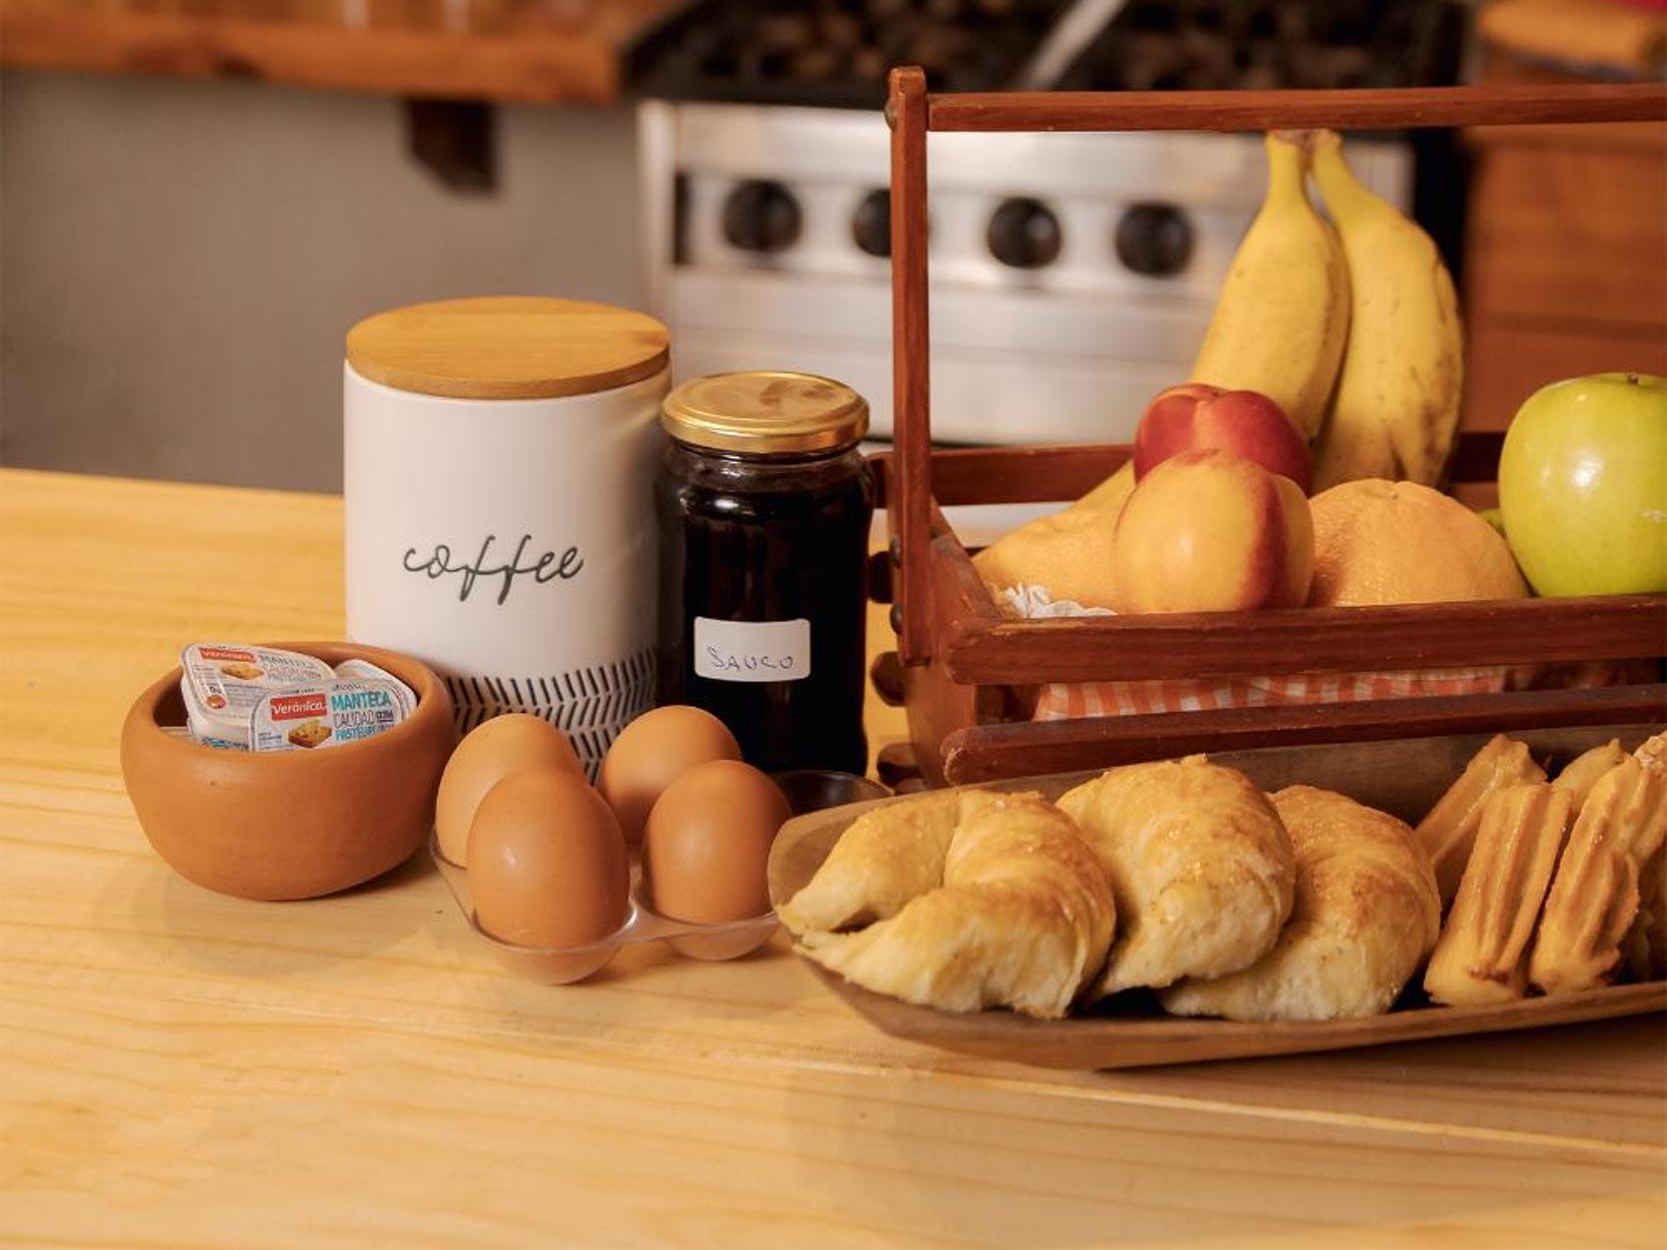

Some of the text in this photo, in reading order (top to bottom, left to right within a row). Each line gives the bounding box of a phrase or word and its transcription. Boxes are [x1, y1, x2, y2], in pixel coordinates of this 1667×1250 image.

[403, 534, 585, 606] coffee
[706, 645, 795, 672] SAUCO
[331, 691, 392, 711] MANTECA
